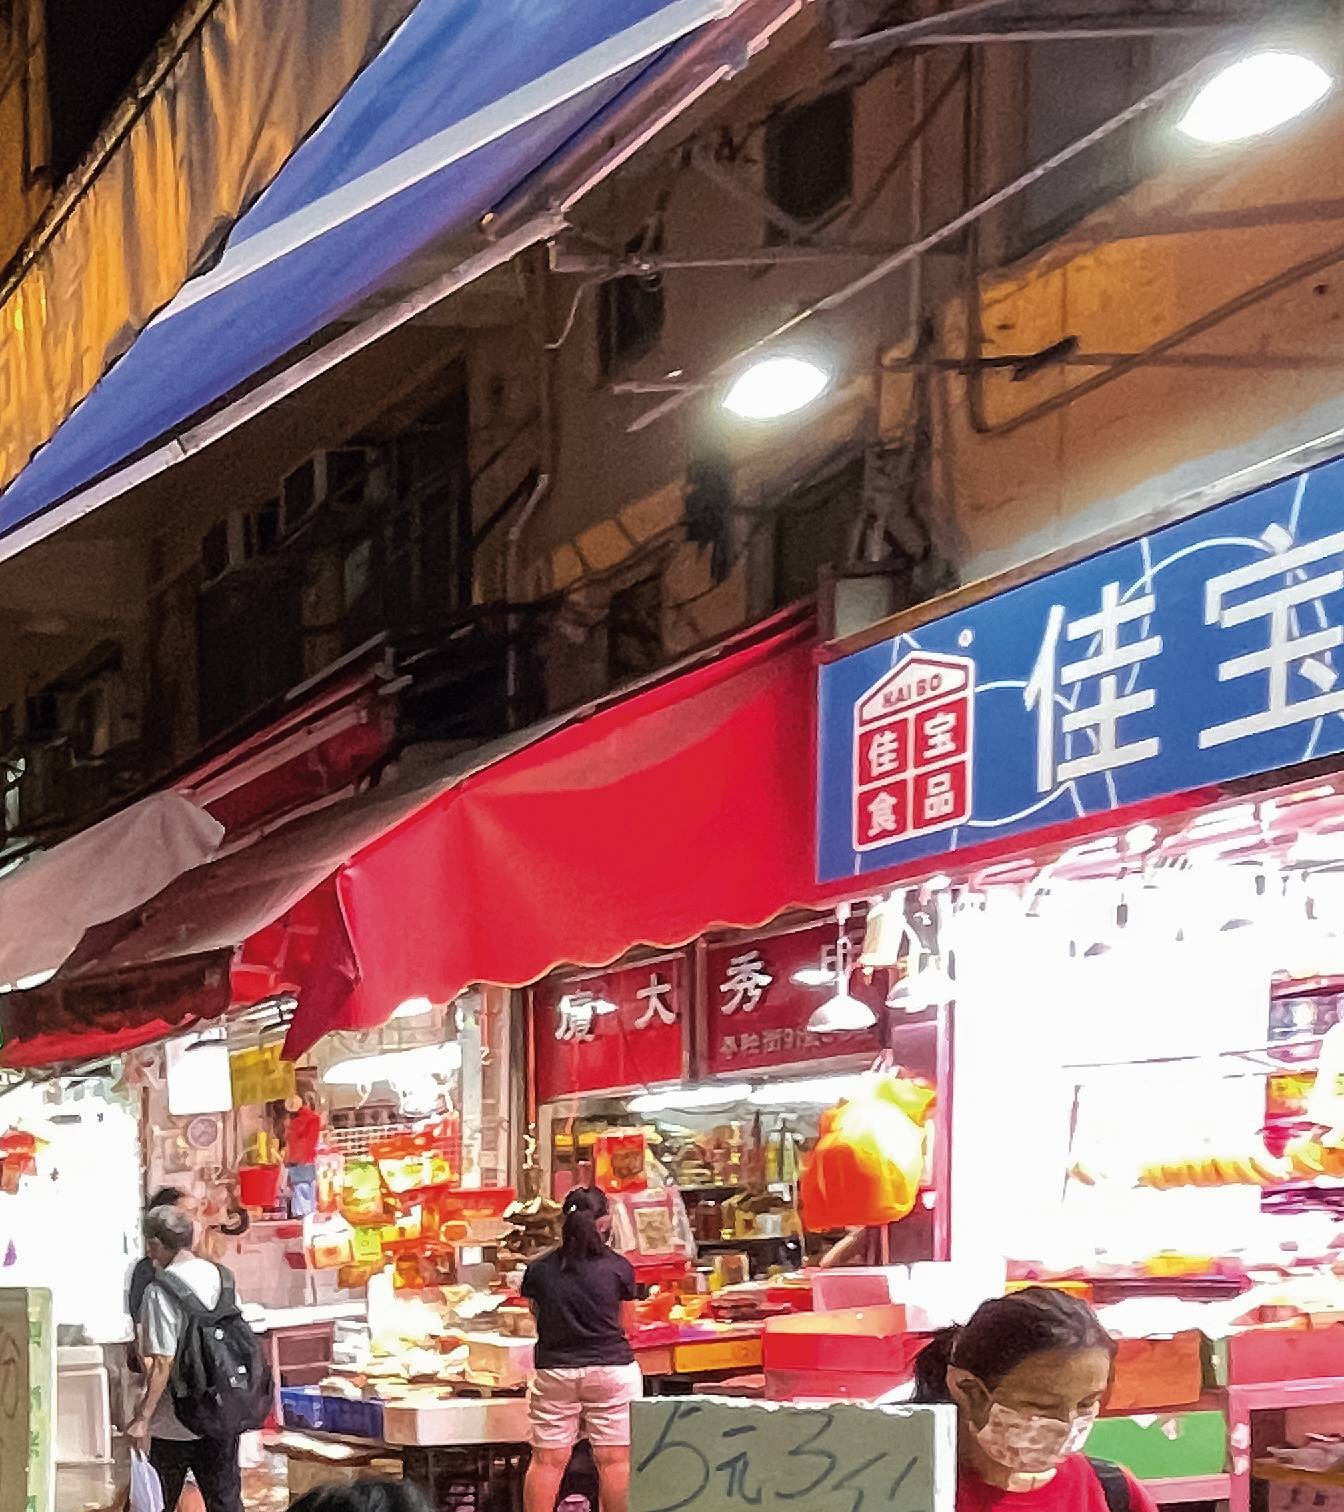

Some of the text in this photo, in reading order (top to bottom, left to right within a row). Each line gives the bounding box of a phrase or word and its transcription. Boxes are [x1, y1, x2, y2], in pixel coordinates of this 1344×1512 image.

[881, 682, 912, 709] KAI
[867, 710, 957, 777] 佳宝
[866, 772, 956, 838] 食品
